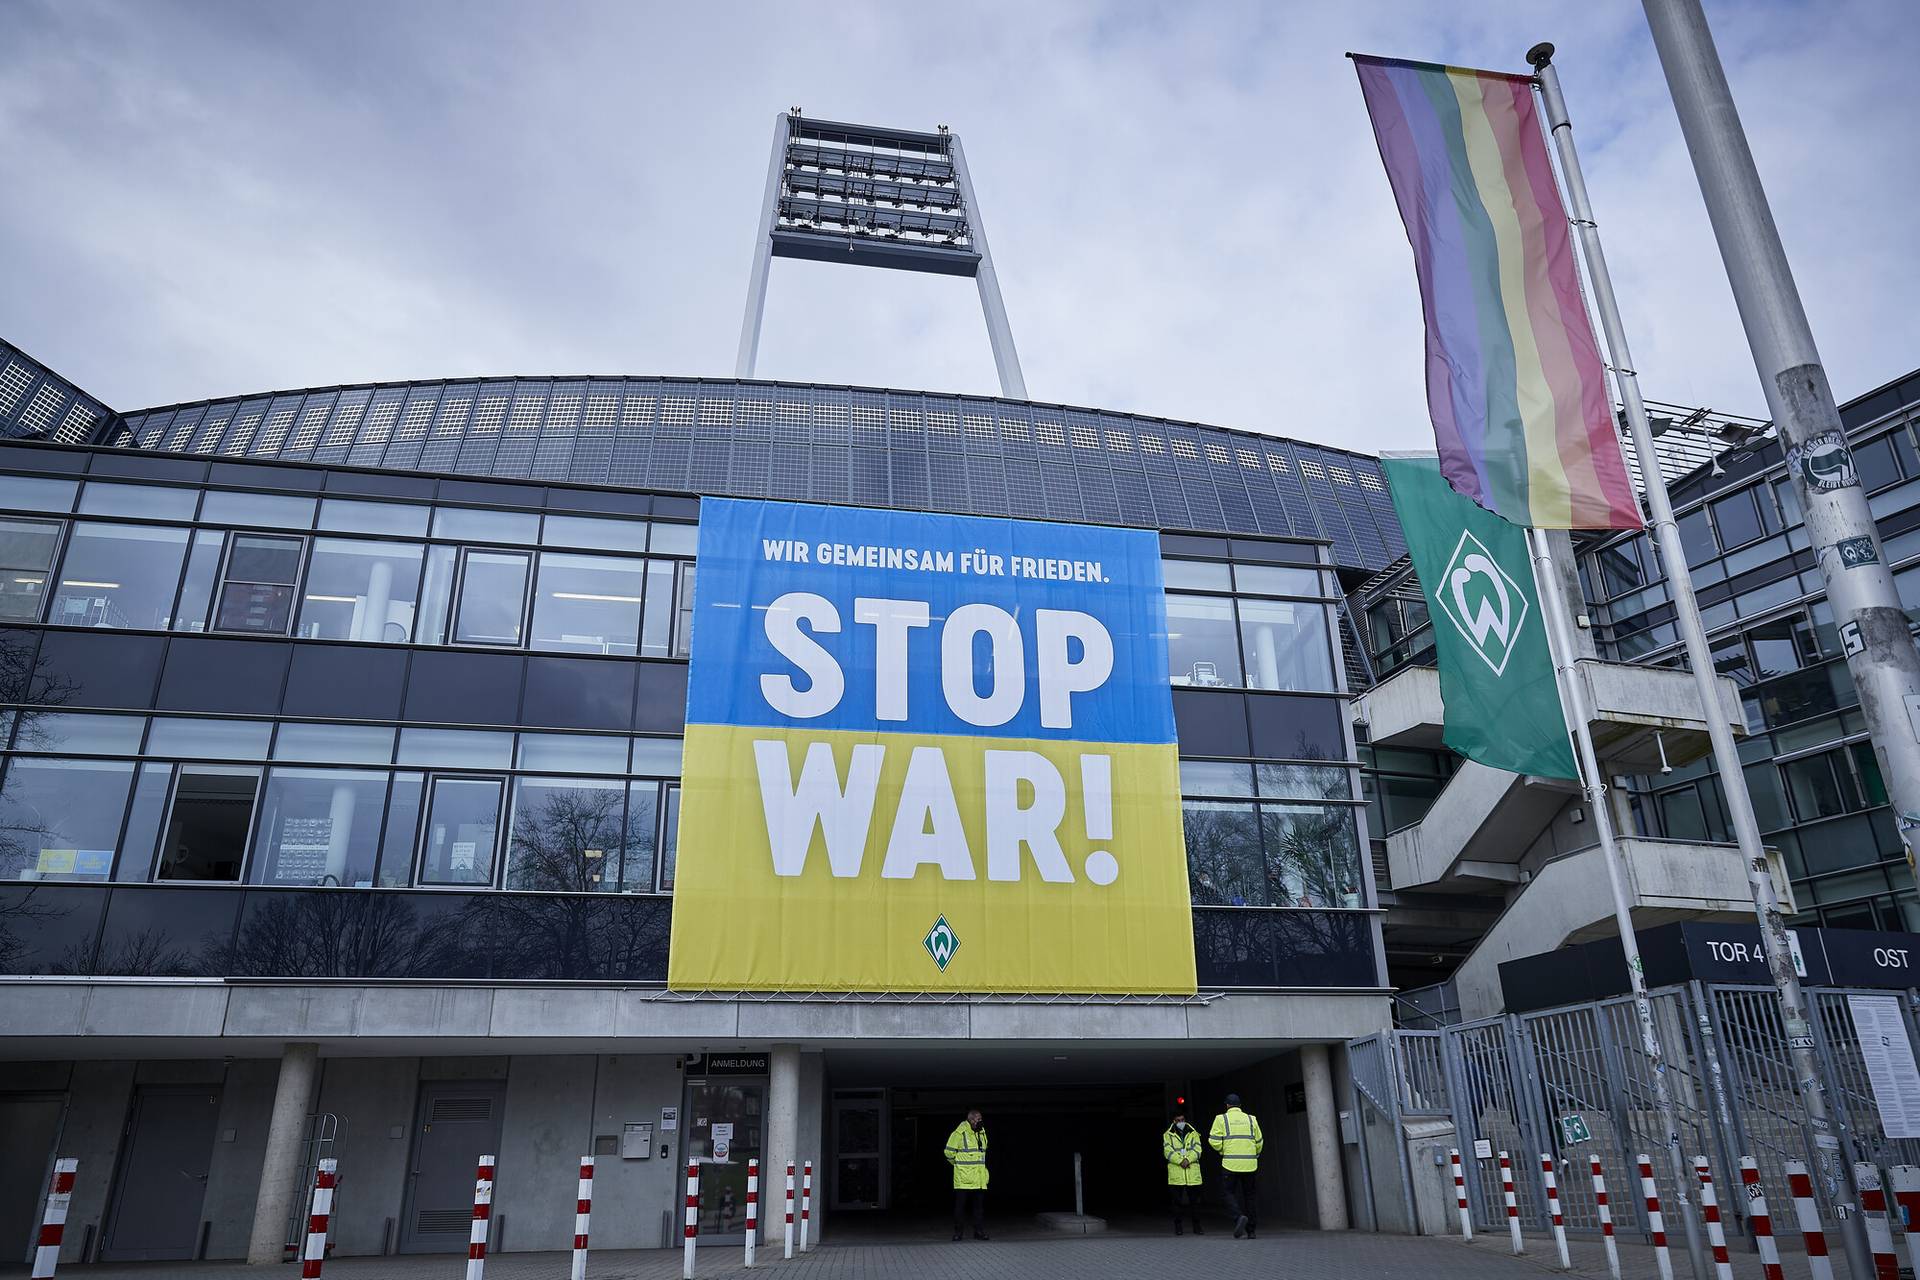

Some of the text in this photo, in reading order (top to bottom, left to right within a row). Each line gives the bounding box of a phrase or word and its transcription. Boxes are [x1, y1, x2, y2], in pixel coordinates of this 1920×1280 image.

[763, 539, 1110, 583] WIR GEMEINSAM FÜR FRIEDEN.
[759, 592, 1114, 729] STOP
[752, 738, 1120, 887] WAR!
[1707, 941, 1764, 963] TOR 4
[1873, 947, 1909, 968] OST
[711, 1059, 765, 1068] ANMELDUNG
